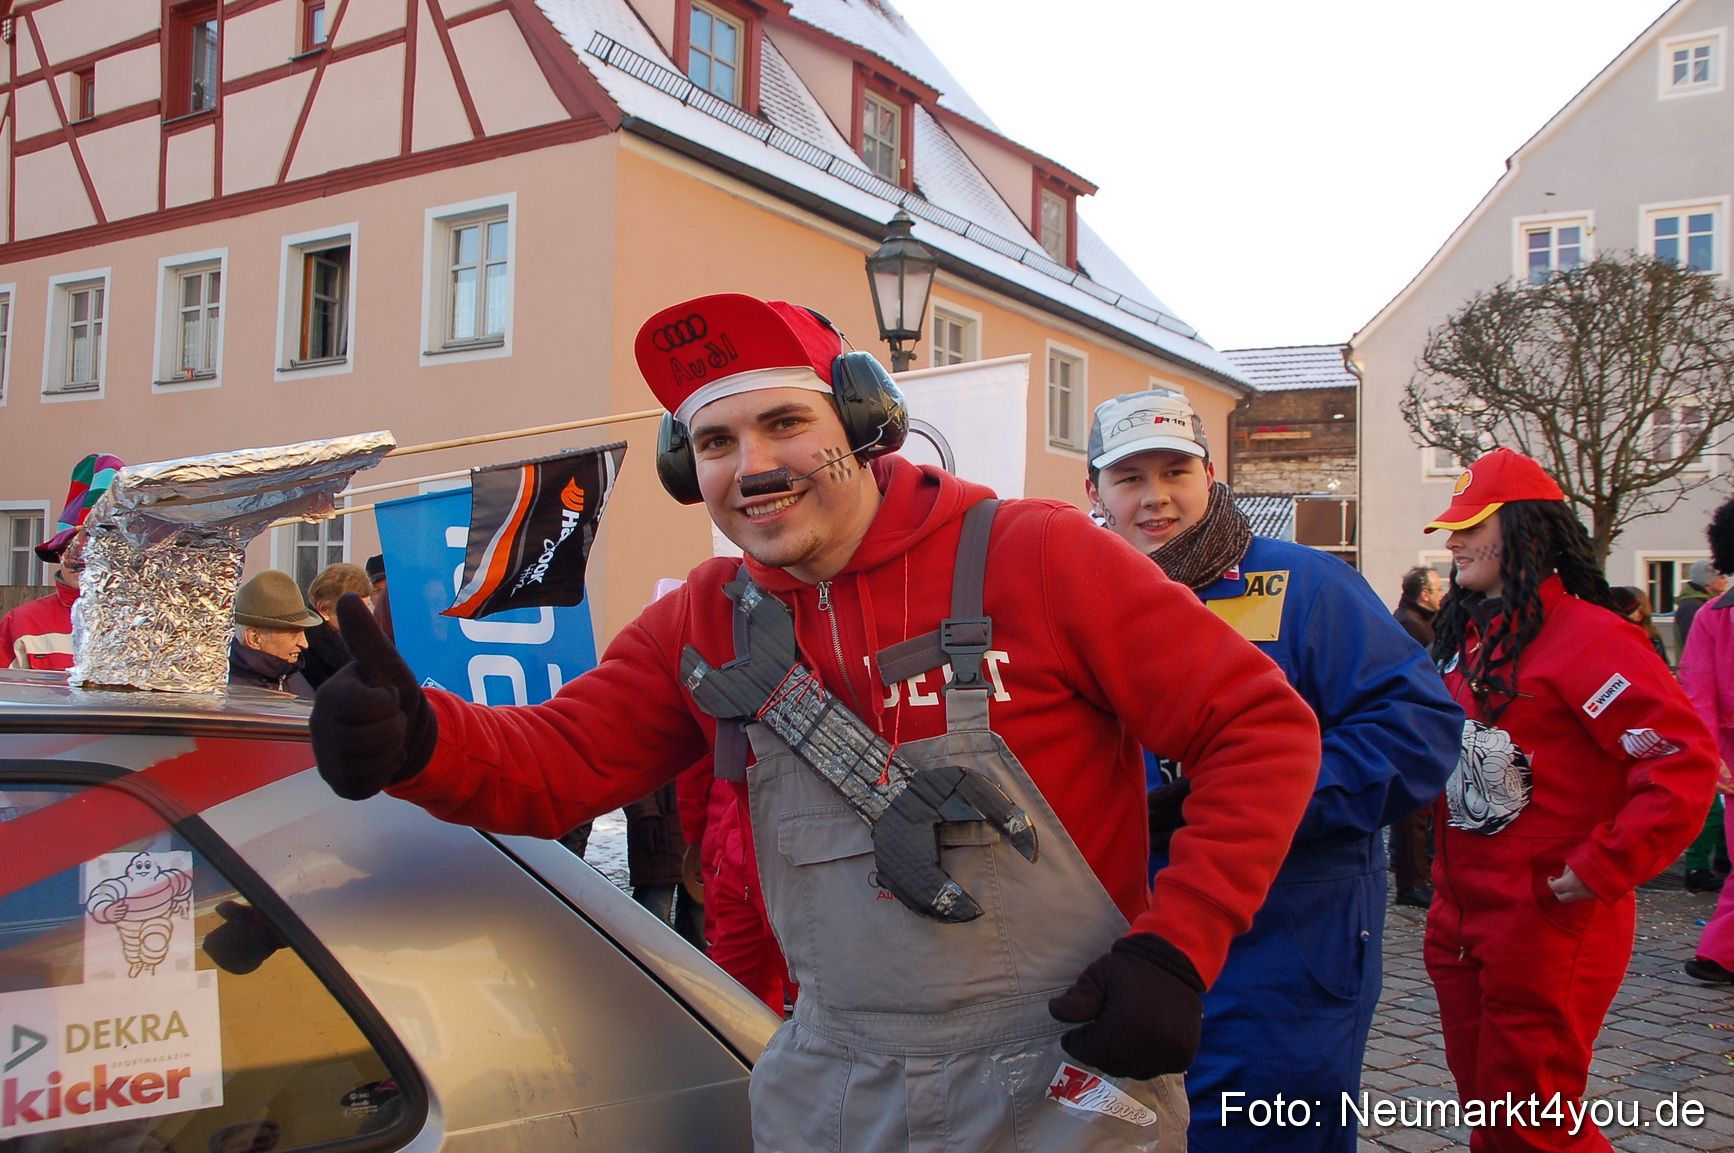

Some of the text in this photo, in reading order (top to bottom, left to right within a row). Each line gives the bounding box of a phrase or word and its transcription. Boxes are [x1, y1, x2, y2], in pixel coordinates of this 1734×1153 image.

[65, 1010, 189, 1054] DEKRA
[111, 1052, 191, 1069] SPORTMAGAZIN
[1, 1064, 191, 1128] kicker
[1063, 1065, 1154, 1125] TV Movie
